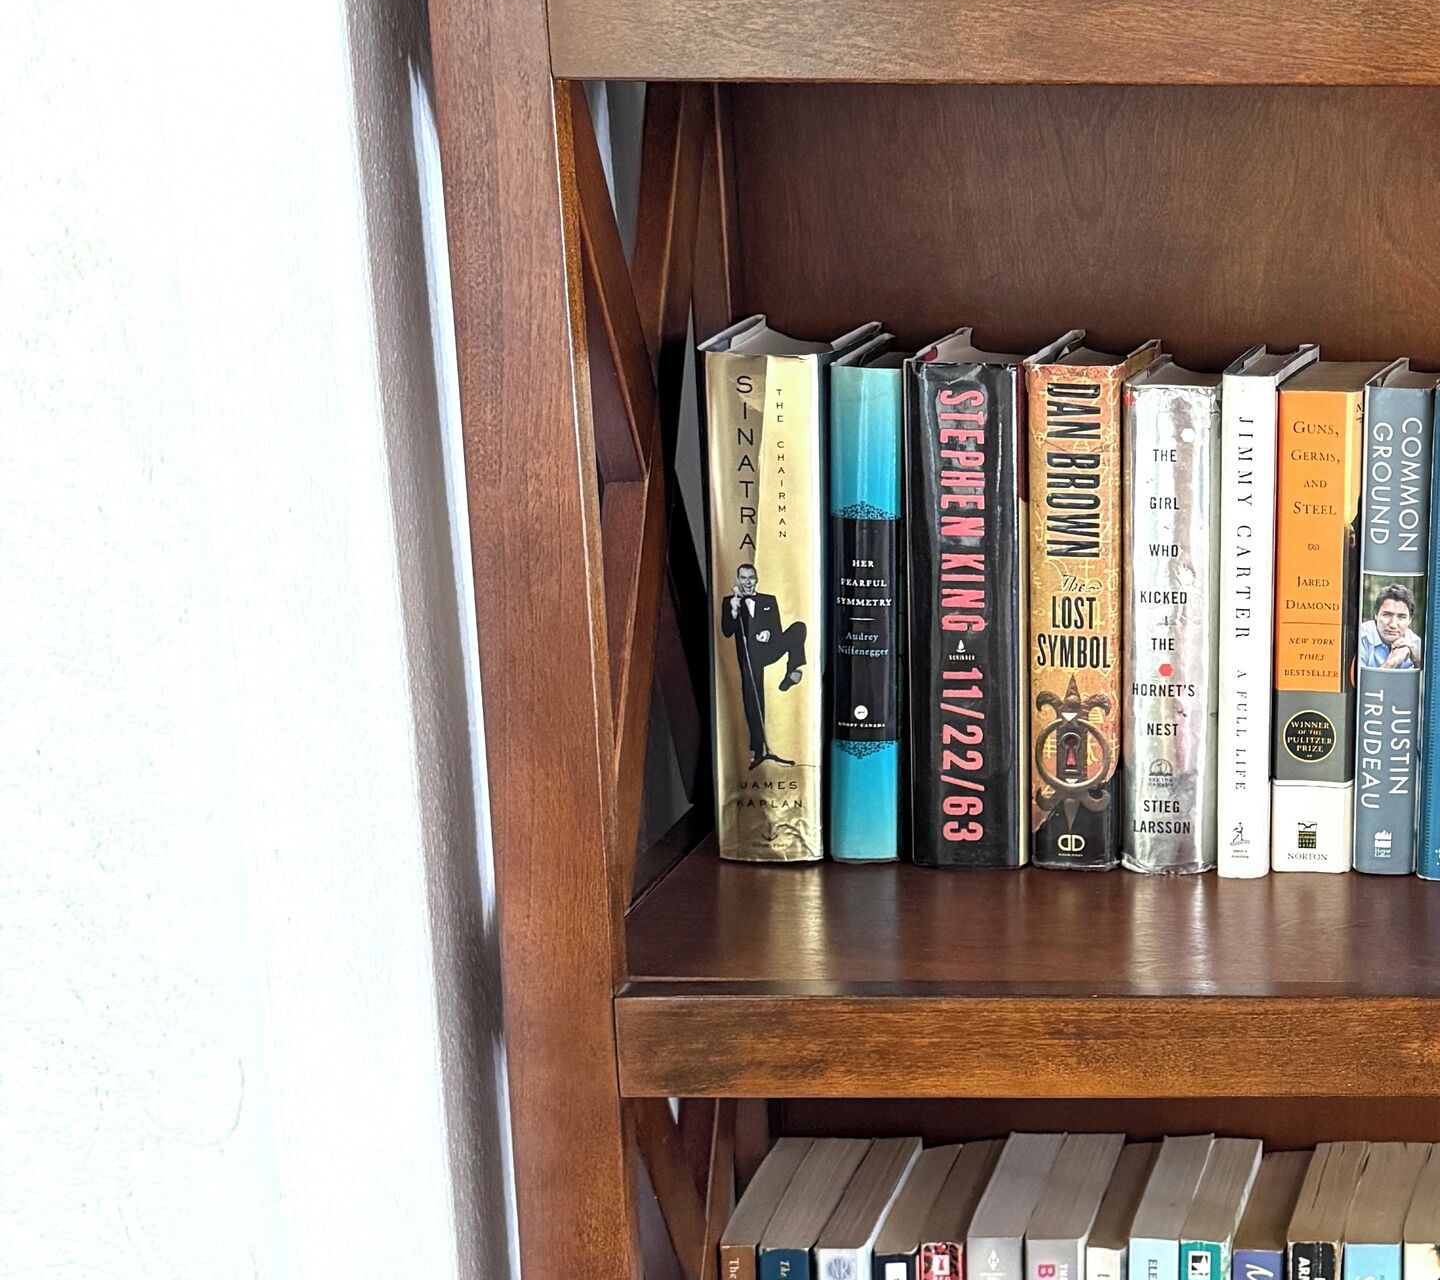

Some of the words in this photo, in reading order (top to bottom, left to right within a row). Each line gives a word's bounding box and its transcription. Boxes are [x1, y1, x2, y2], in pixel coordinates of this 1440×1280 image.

[776, 389, 784, 423] THE
[1046, 382, 1101, 440] DAN
[1292, 421, 1339, 437] GUNS,
[736, 375, 757, 550] SINATRA
[1153, 449, 1177, 463] THE
[1237, 416, 1254, 506] JIMMY
[1291, 449, 1340, 464] GERMS,
[938, 389, 986, 539] STEPHEN
[777, 441, 787, 539] CHAIRMAN
[1303, 479, 1327, 489] AND
[1370, 422, 1394, 545] GROUND
[1397, 417, 1423, 552] COMMON
[1045, 454, 1101, 559] BROWN
[1149, 497, 1180, 511] GIRL
[1292, 501, 1337, 516] STEEL
[1149, 544, 1179, 558] WHO
[852, 560, 875, 568] HER
[841, 578, 888, 588] FEARFUL
[1235, 525, 1252, 639] CARTER
[1296, 576, 1330, 588] JARED
[939, 553, 986, 633] KING
[1140, 590, 1187, 605] KICKED
[836, 597, 892, 608] SYMMETRY
[1285, 599, 1340, 612] DIAMOND
[1051, 597, 1096, 630] LOST
[846, 632, 879, 643] Audrey
[1151, 638, 1175, 651] THE
[838, 645, 889, 657] Niffenegger
[1037, 634, 1111, 669] SYMBOL
[1132, 683, 1195, 697] HORNET'S
[1147, 724, 1179, 737] NEST
[940, 666, 986, 842] 11/22/63
[1360, 690, 1384, 809] TRUDEAU
[1388, 706, 1412, 795] JUSTIN
[1143, 800, 1180, 814] STIEG
[1133, 821, 1191, 835] LARSSON
